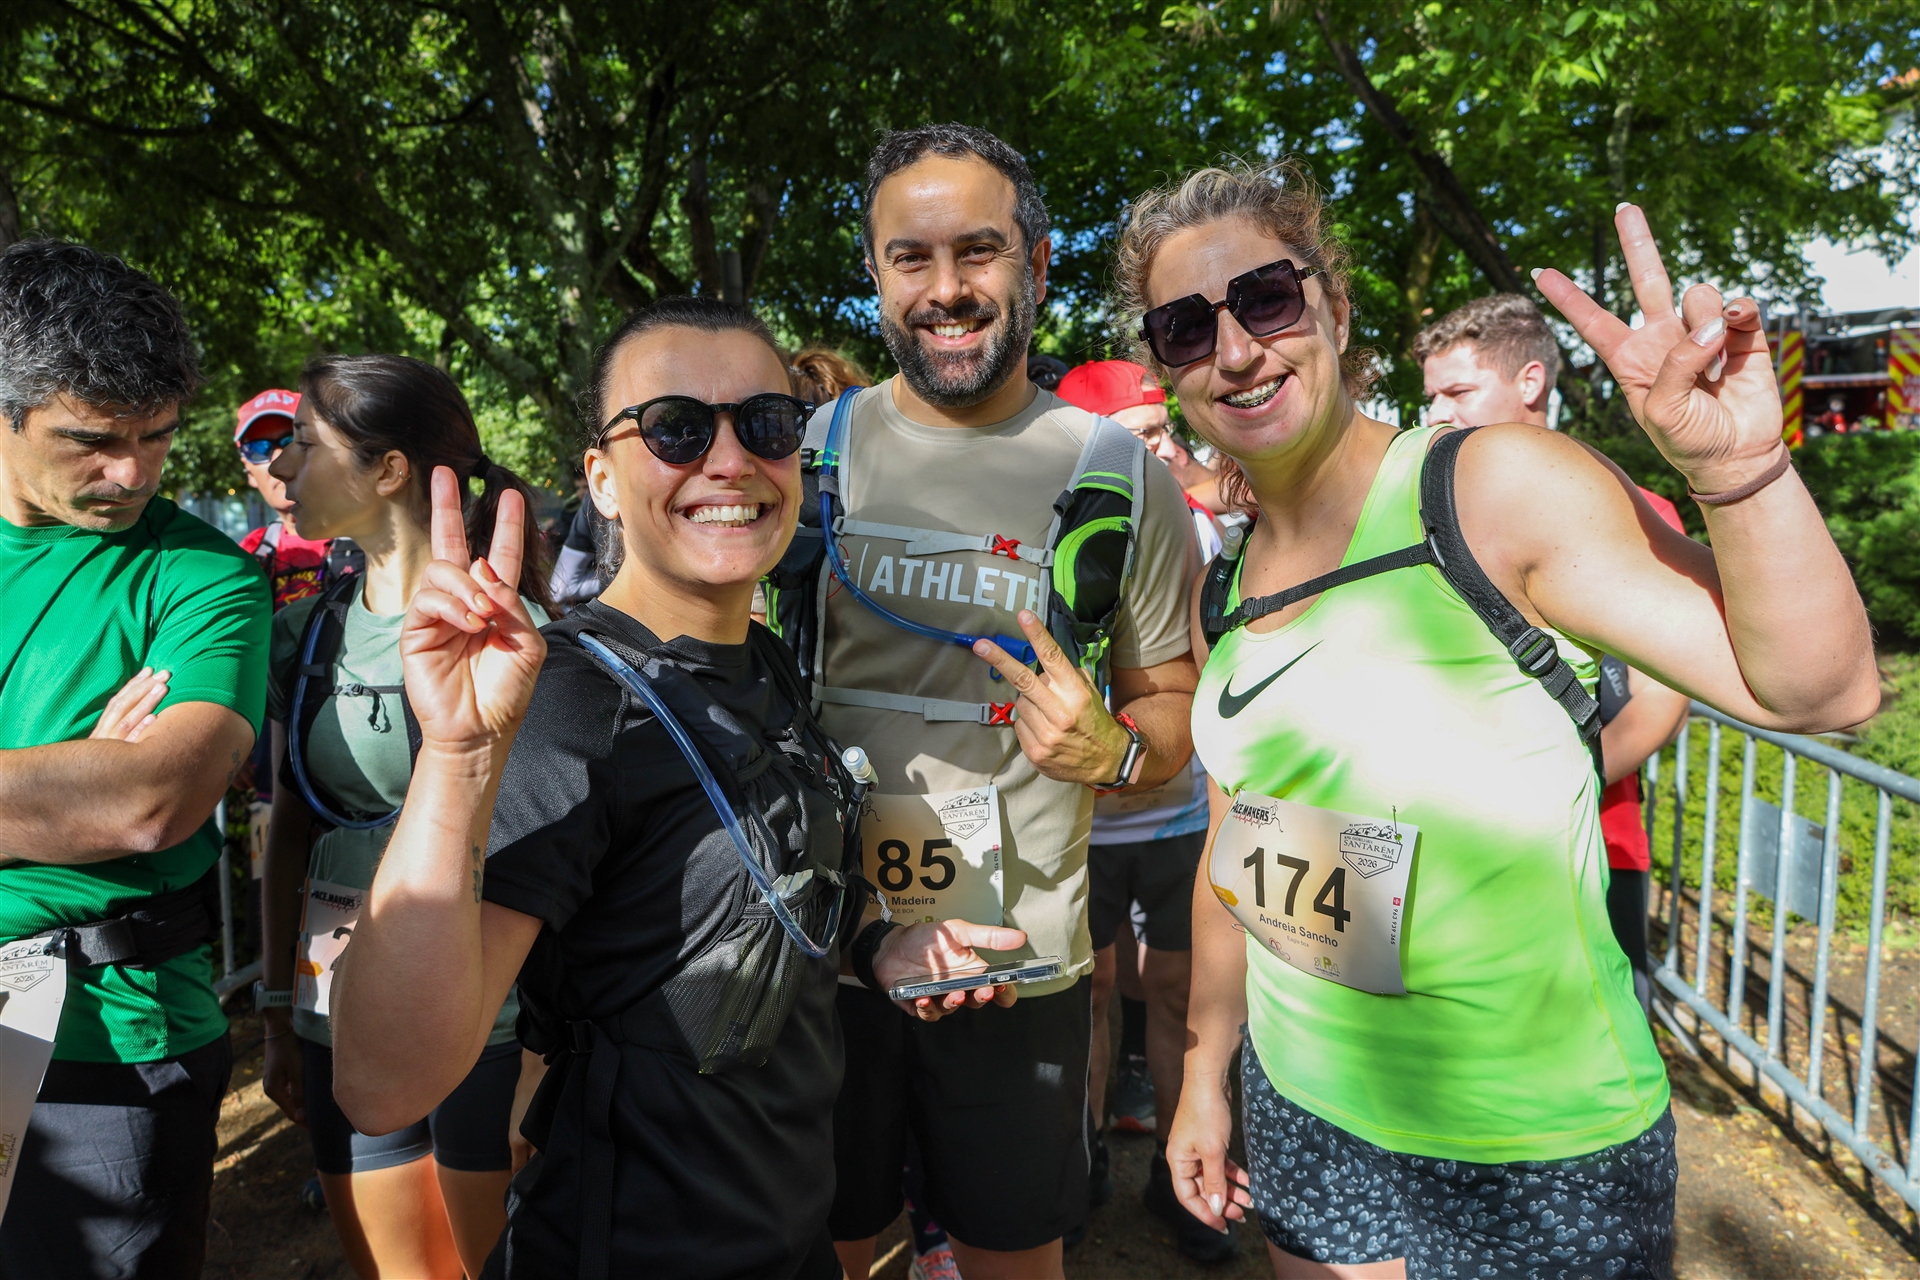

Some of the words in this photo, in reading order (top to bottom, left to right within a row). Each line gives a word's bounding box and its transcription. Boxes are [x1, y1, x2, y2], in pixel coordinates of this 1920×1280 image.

[943, 808, 985, 820] SANTARÉM
[957, 822, 975, 831] 2026
[1343, 839, 1395, 856] SANTARÉM
[861, 838, 956, 891] 85
[1357, 857, 1378, 868] 2026
[1243, 846, 1350, 933] 174
[891, 896, 936, 905] Madeira
[1259, 913, 1297, 934] Andreia
[1298, 926, 1339, 948] Sancho
[0, 959, 48, 971] ANTARÉM
[13, 974, 35, 984] 2026
